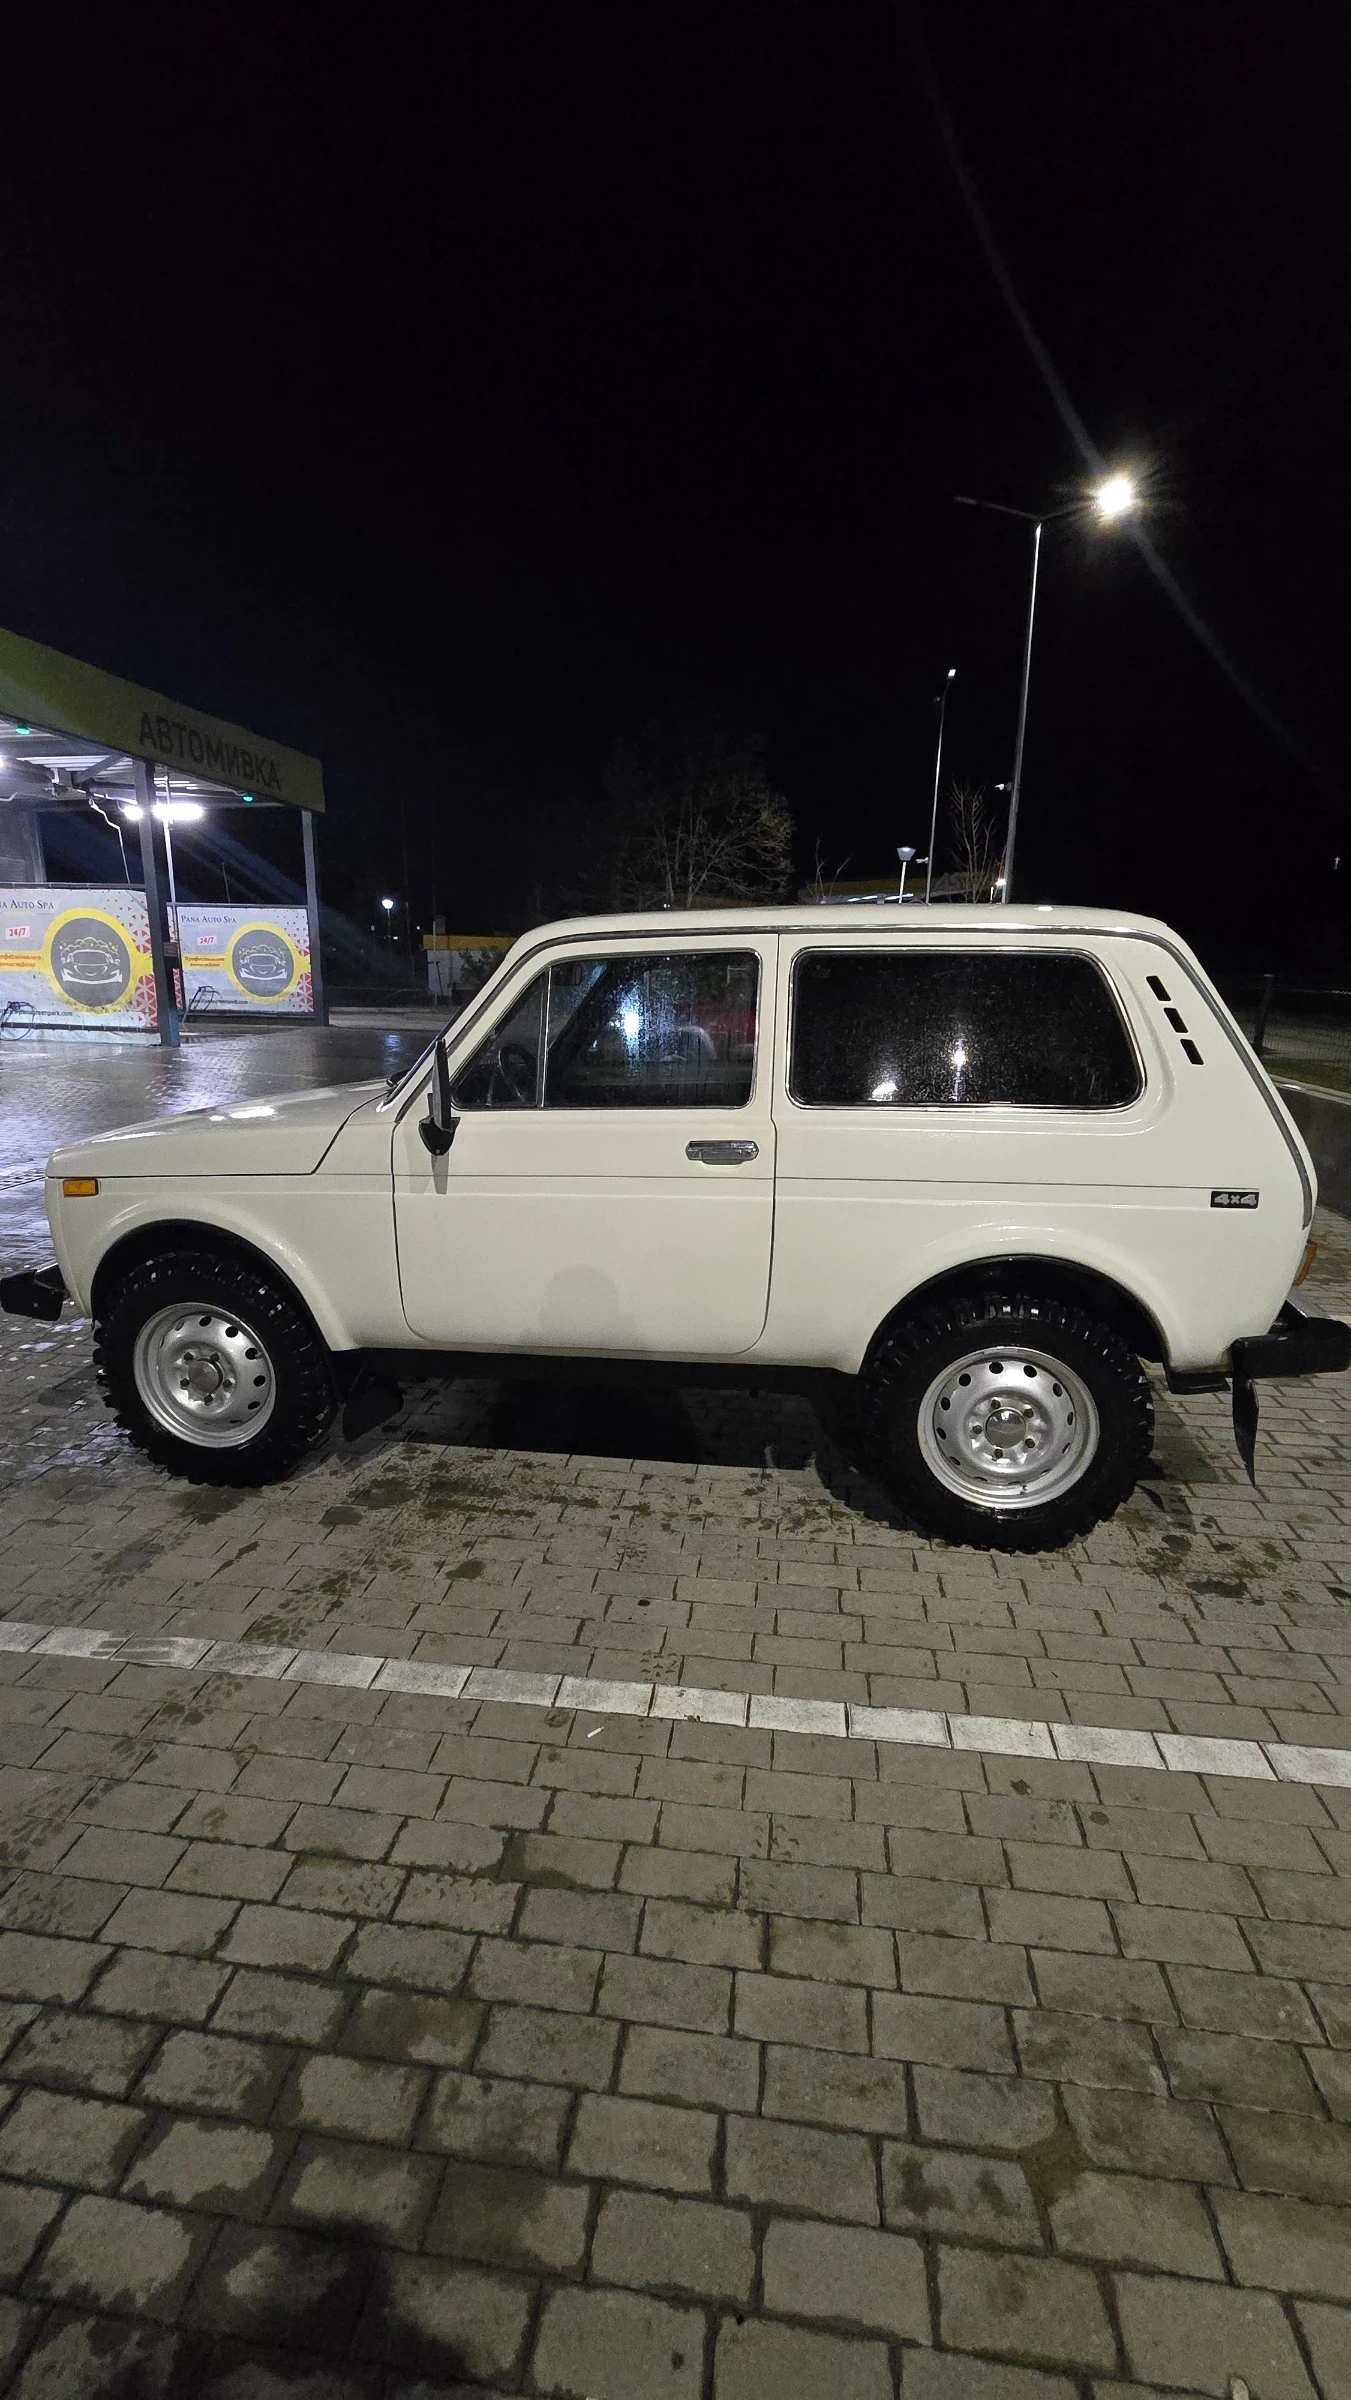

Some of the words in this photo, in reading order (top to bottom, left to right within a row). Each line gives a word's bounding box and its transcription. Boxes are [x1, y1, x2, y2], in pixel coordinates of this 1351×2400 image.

[138, 711, 283, 792] АВТОМИВКА
[9, 927, 27, 937] 24/7
[200, 936, 215, 944] 24/7
[1213, 1193, 1257, 1206] 4x4
